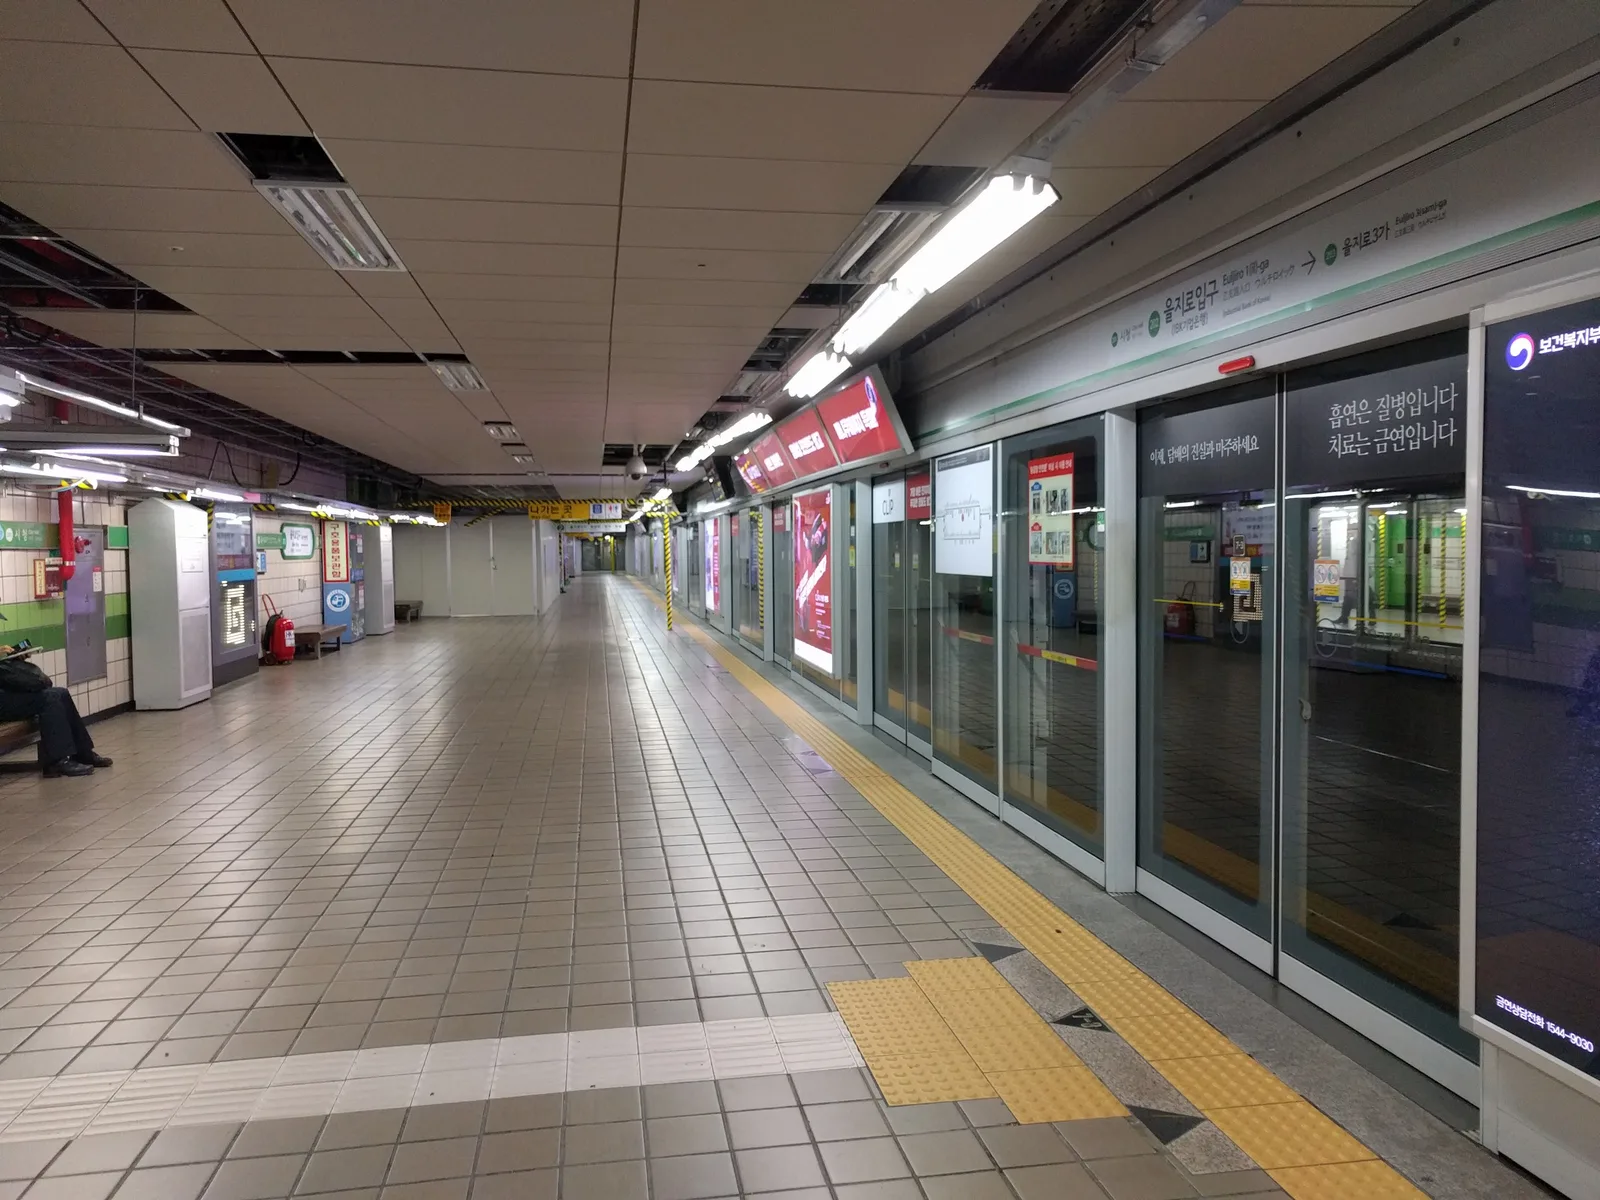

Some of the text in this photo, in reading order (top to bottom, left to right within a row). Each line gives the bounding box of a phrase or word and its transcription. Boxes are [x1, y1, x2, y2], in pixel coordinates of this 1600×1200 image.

[1342, 221, 1390, 257] 을지로3가
[1163, 279, 1220, 324] 을지로입구
[1329, 382, 1458, 430] 흡연은 질병입니다
[1150, 435, 1259, 467] 이제, 담배의 진실과 마주하세요
[1328, 418, 1458, 458] 치료는 금연입니다
[530, 504, 572, 515] 나가는 곳
[15, 528, 28, 542] 시청
[1495, 994, 1594, 1053] 금연상담전화 1544-9030
